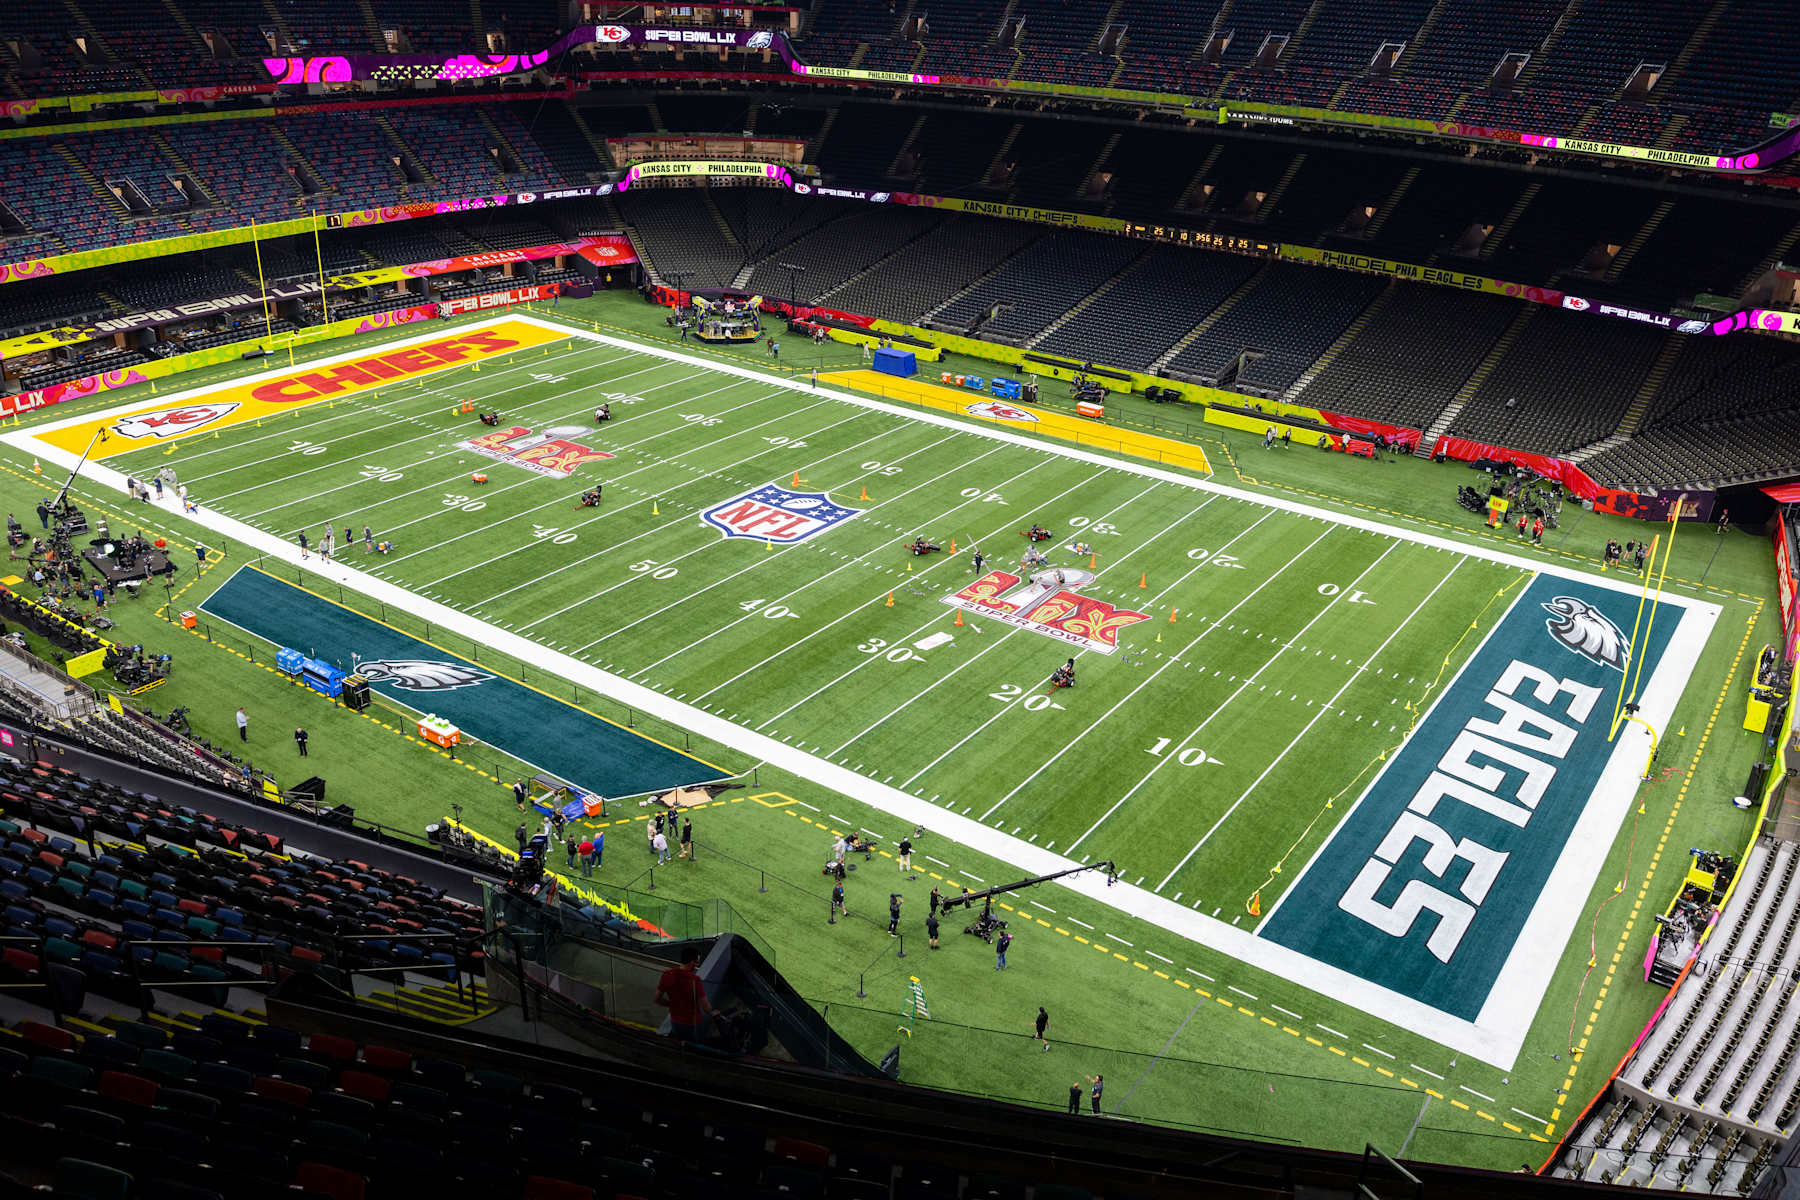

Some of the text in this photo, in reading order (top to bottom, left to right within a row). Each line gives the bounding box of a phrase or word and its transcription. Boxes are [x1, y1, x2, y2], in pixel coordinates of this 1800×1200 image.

[645, 29, 736, 44] SUPER BOWL LIX
[811, 68, 835, 76] KANSAS
[868, 71, 909, 81] PHILADELPHIA
[1564, 140, 1710, 166] KANSAS CITY PHILADELPHIA
[642, 164, 762, 174] KANSAS CITY PHILADELPHIA
[963, 200, 1078, 224] KANSAS CITY CHIEFS
[1153, 226, 1164, 236] 25
[1180, 232, 1188, 241] 10
[1213, 236, 1223, 246] 25
[1238, 239, 1248, 249] 25
[463, 250, 524, 263] CAESARS
[470, 254, 528, 267] SUPERDOME
[1322, 251, 1483, 289] PHILADELPHIA EAGLES
[94, 281, 324, 333] SUPER BOWL LIX
[479, 291, 518, 308] BOWL
[518, 287, 539, 301] LIX
[251, 331, 520, 405] CHIEFS
[14, 390, 46, 412] LIX
[358, 464, 403, 482] 20
[861, 461, 904, 476] 50
[442, 495, 487, 512] 30
[714, 500, 811, 539] NFL
[1068, 516, 1115, 534] 30
[532, 527, 577, 544] 40
[1187, 548, 1239, 567] 20
[629, 560, 678, 580] 50
[1316, 583, 1368, 603] 10
[739, 599, 789, 619] 40
[960, 601, 1096, 647] SUPER BOWL
[857, 638, 913, 663] 30
[989, 684, 1051, 711] 20
[1143, 737, 1206, 766] 10
[1337, 658, 1604, 965] EAGLES
